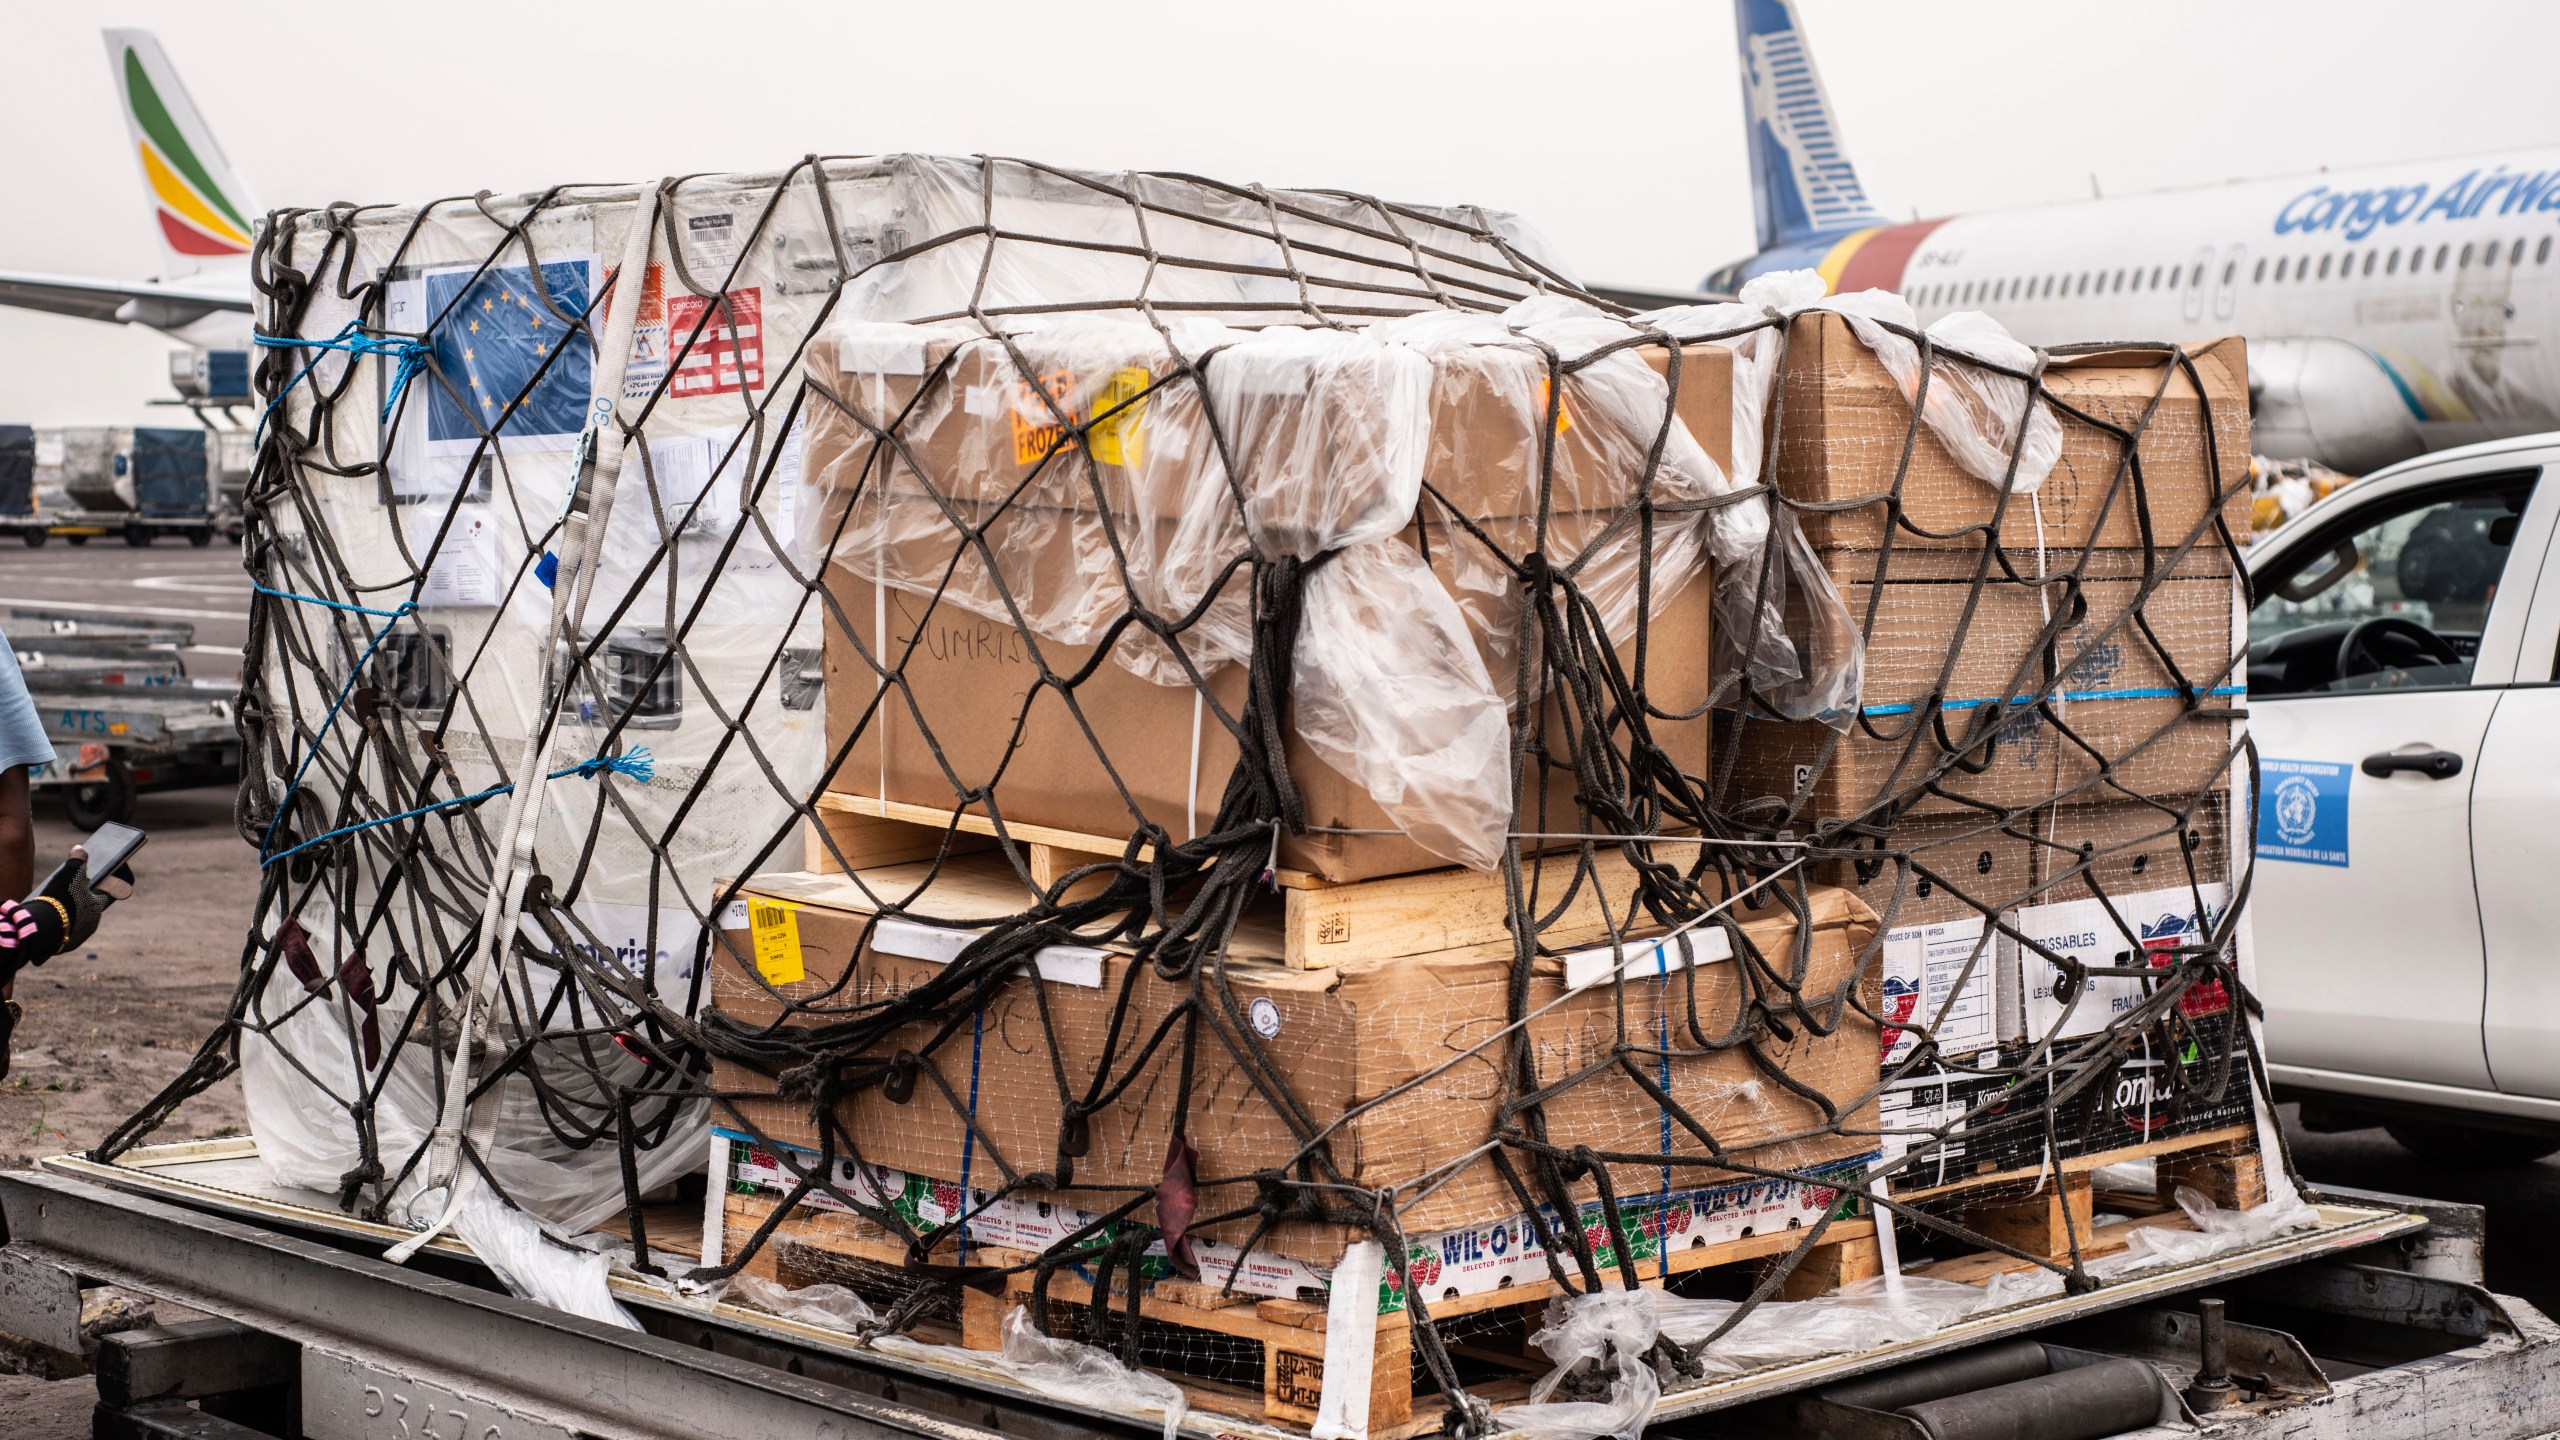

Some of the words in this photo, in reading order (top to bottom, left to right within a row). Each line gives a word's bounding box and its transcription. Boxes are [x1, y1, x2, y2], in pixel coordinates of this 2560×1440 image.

[2274, 185, 2430, 241] Congo
[672, 300, 703, 311] cencora
[626, 374, 642, 382] STORE
[640, 380, 650, 388] and
[1017, 423, 1079, 459] FROZE
[61, 708, 107, 734] ATS
[2259, 760, 2280, 773] WORLD
[2279, 762, 2301, 775] HEALTH
[2300, 763, 2340, 777] ORGANIZATION
[2285, 846, 2312, 859] MONDIALE
[2313, 848, 2321, 860] DE
[2321, 849, 2328, 861] LA
[1904, 932, 1911, 941] OF
[1928, 927, 1945, 937] AFRICA
[1945, 1044, 1961, 1054] CITY
[1962, 1042, 1979, 1052] DEEP
[2216, 1105, 2246, 1117] Nature
[1201, 1255, 1235, 1269] SELECTED
[1462, 1260, 1495, 1274] SELECTED
